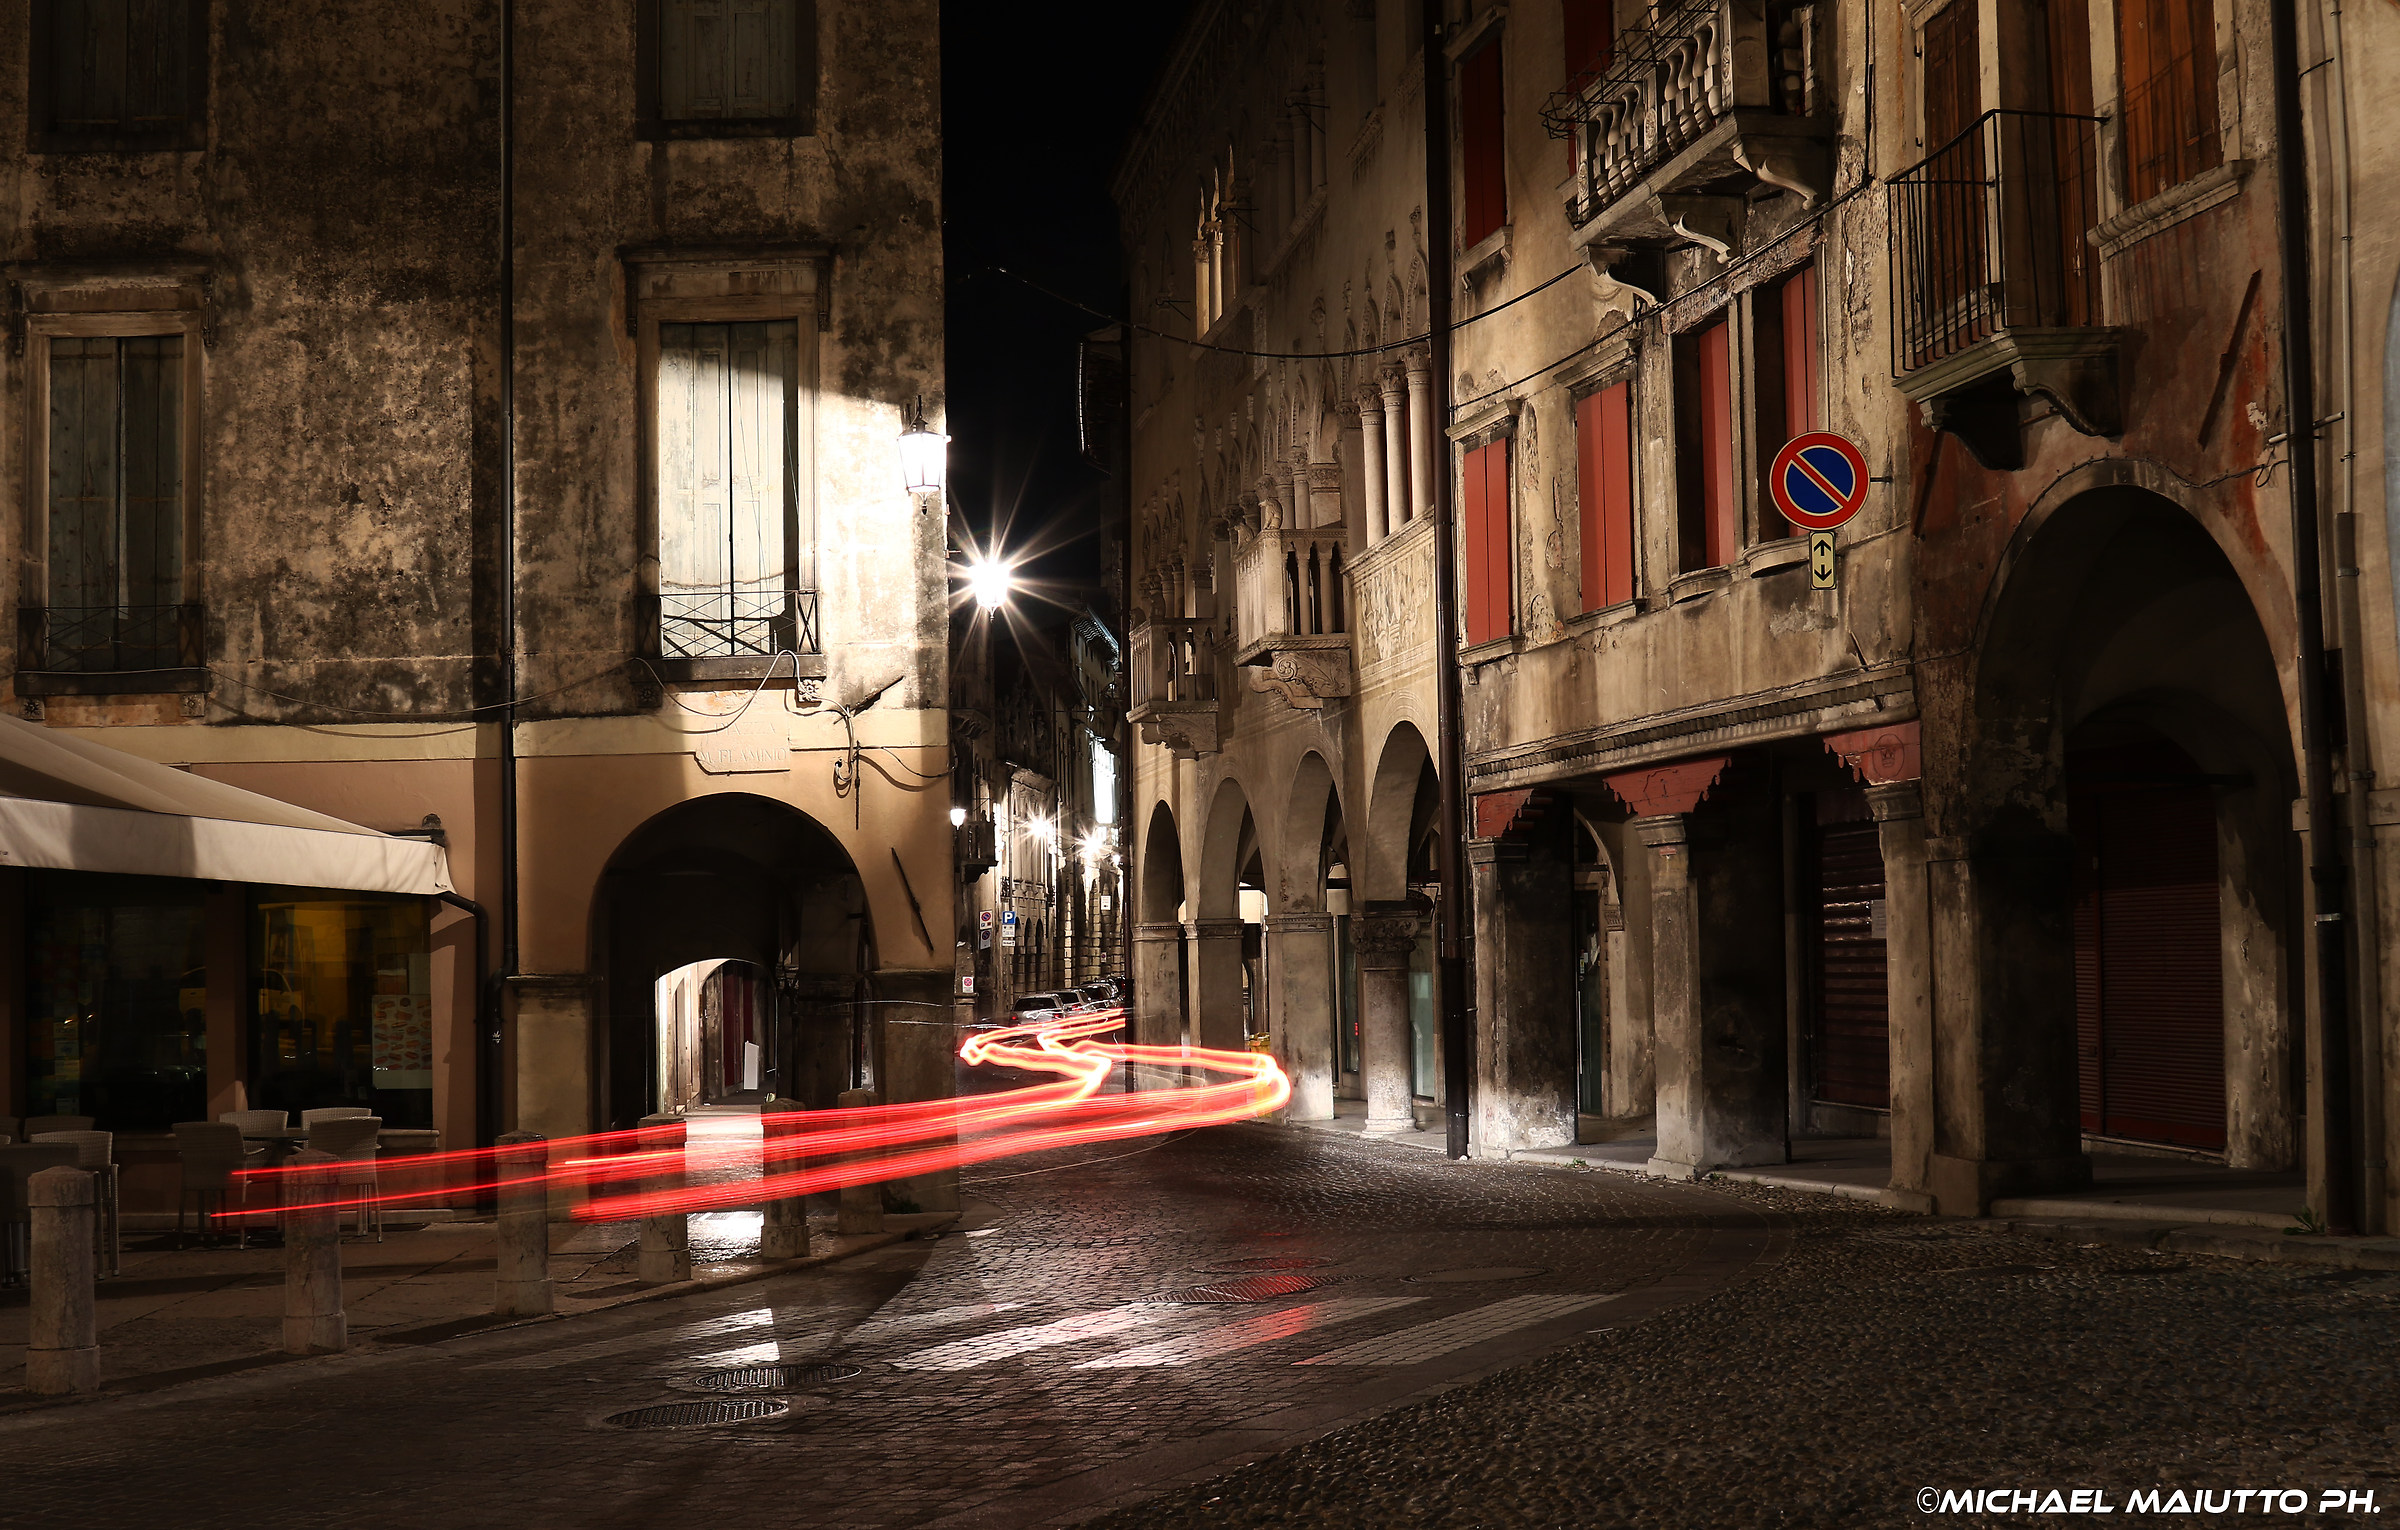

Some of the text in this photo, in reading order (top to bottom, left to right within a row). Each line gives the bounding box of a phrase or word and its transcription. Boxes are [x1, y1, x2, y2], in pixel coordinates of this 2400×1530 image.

[714, 722, 776, 736] PIAZZA
[719, 747, 787, 763] FLAMINIO
[1004, 912, 1013, 923] P
